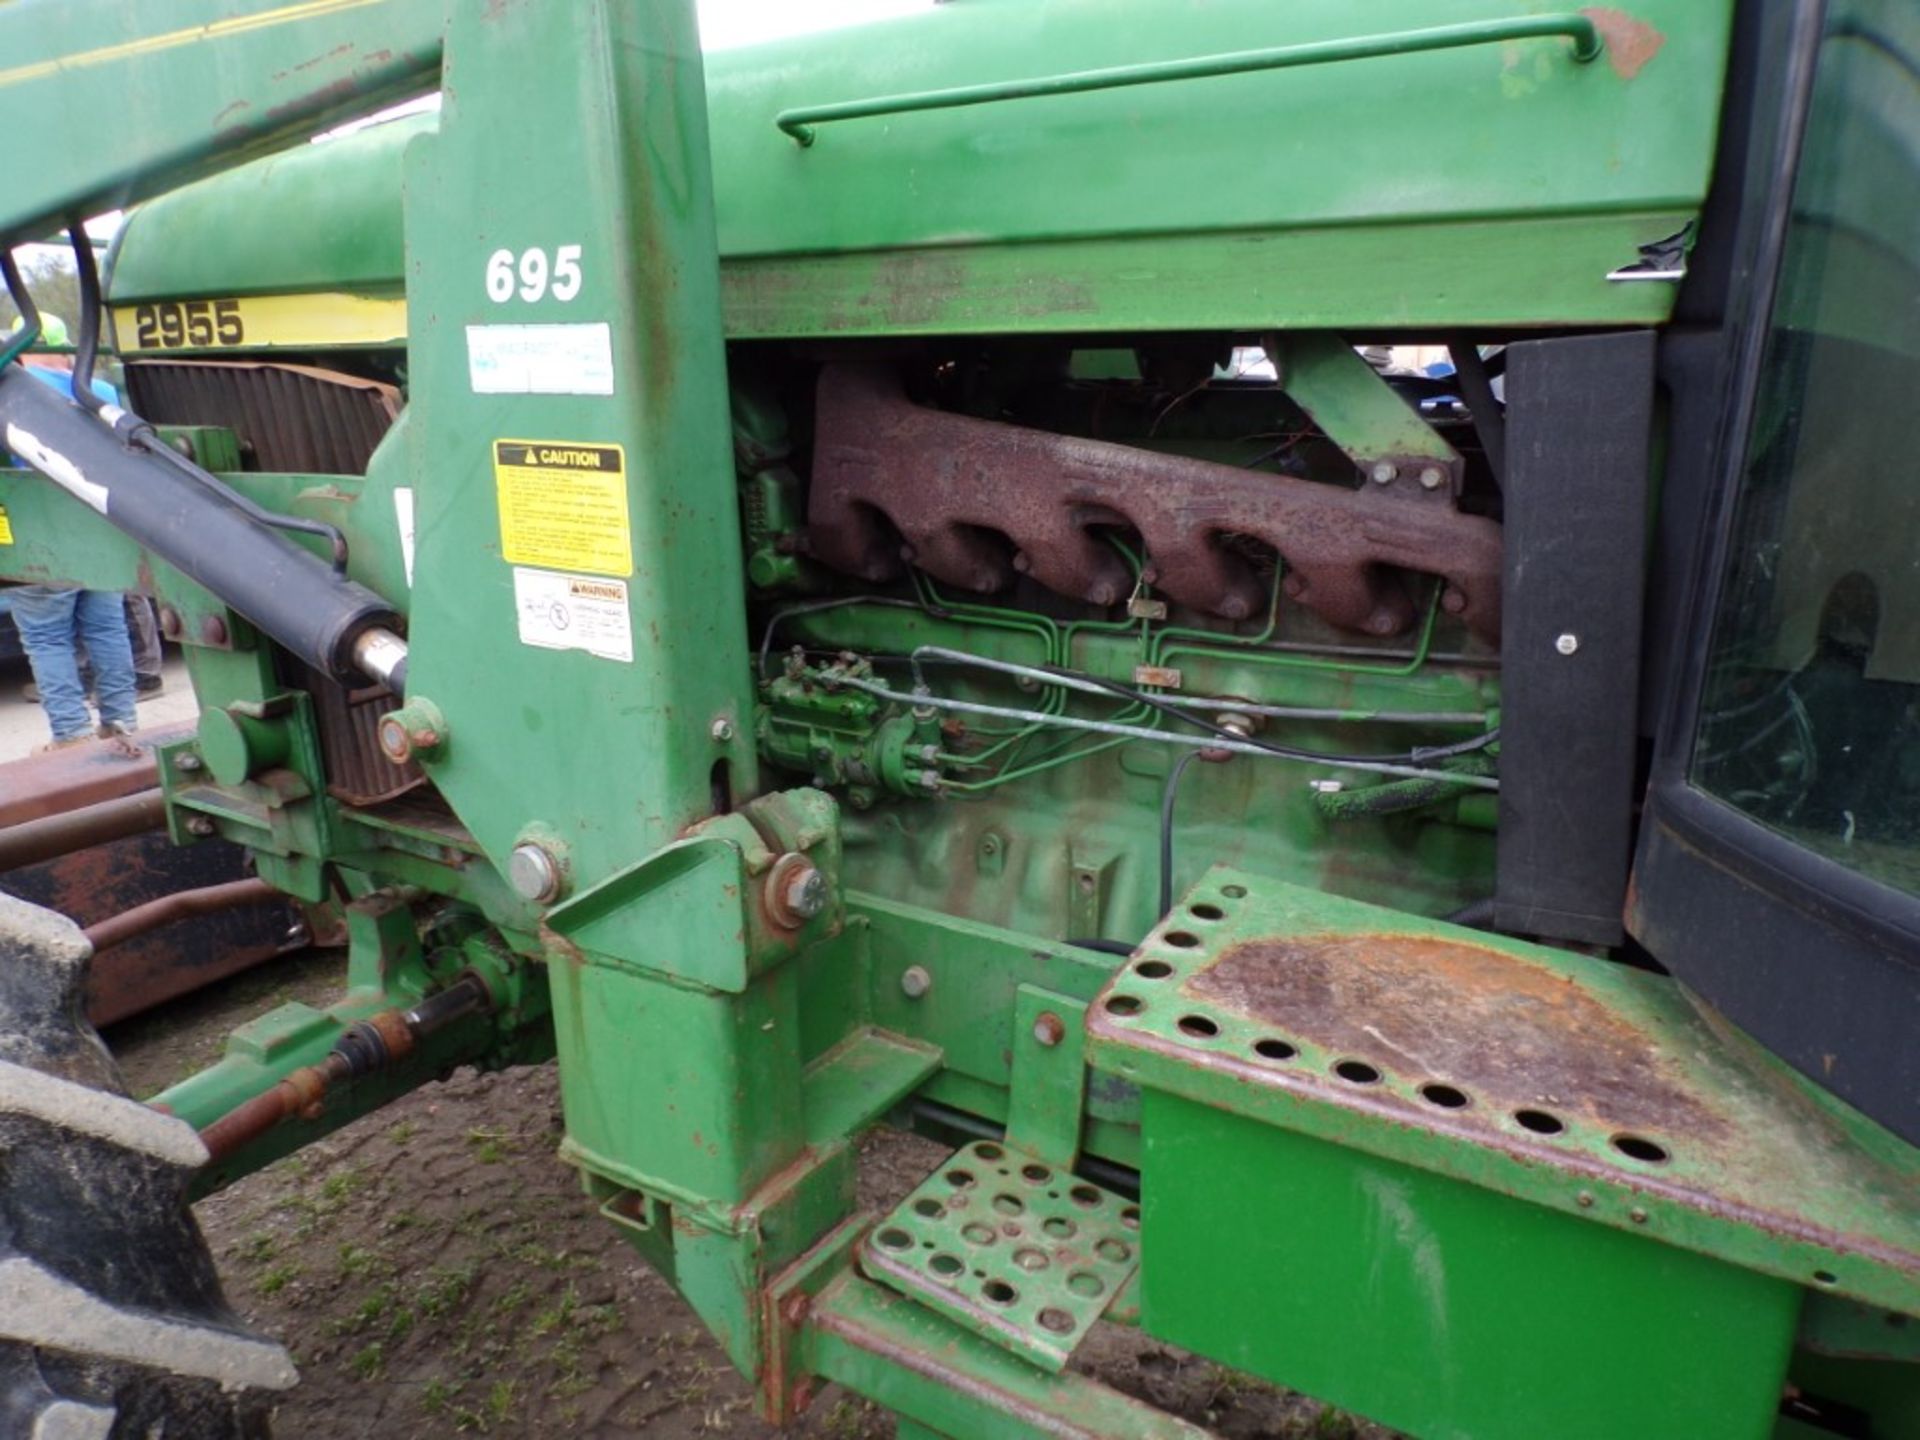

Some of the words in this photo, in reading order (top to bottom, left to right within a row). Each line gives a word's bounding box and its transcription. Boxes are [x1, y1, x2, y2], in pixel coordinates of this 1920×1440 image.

[486, 244, 582, 303] 695
[136, 300, 244, 348] 2955
[540, 449, 600, 467] CAUTION
[579, 583, 623, 600] WARNING
